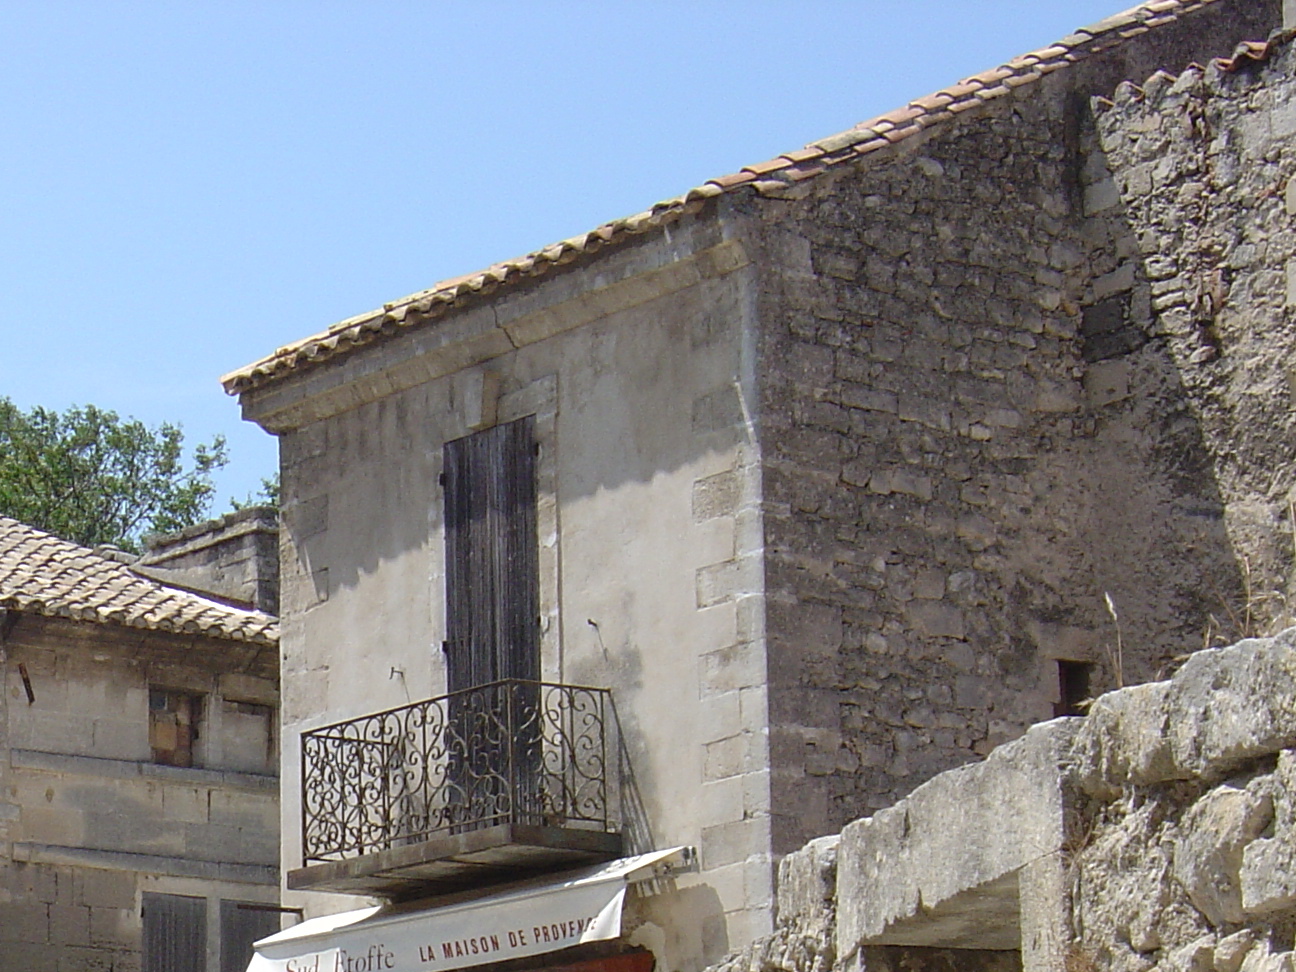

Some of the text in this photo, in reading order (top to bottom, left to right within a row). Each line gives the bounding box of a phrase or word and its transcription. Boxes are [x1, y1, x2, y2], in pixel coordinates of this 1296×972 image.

[419, 945, 436, 963] LA
[441, 934, 500, 959] MAISON
[508, 929, 527, 948] DE
